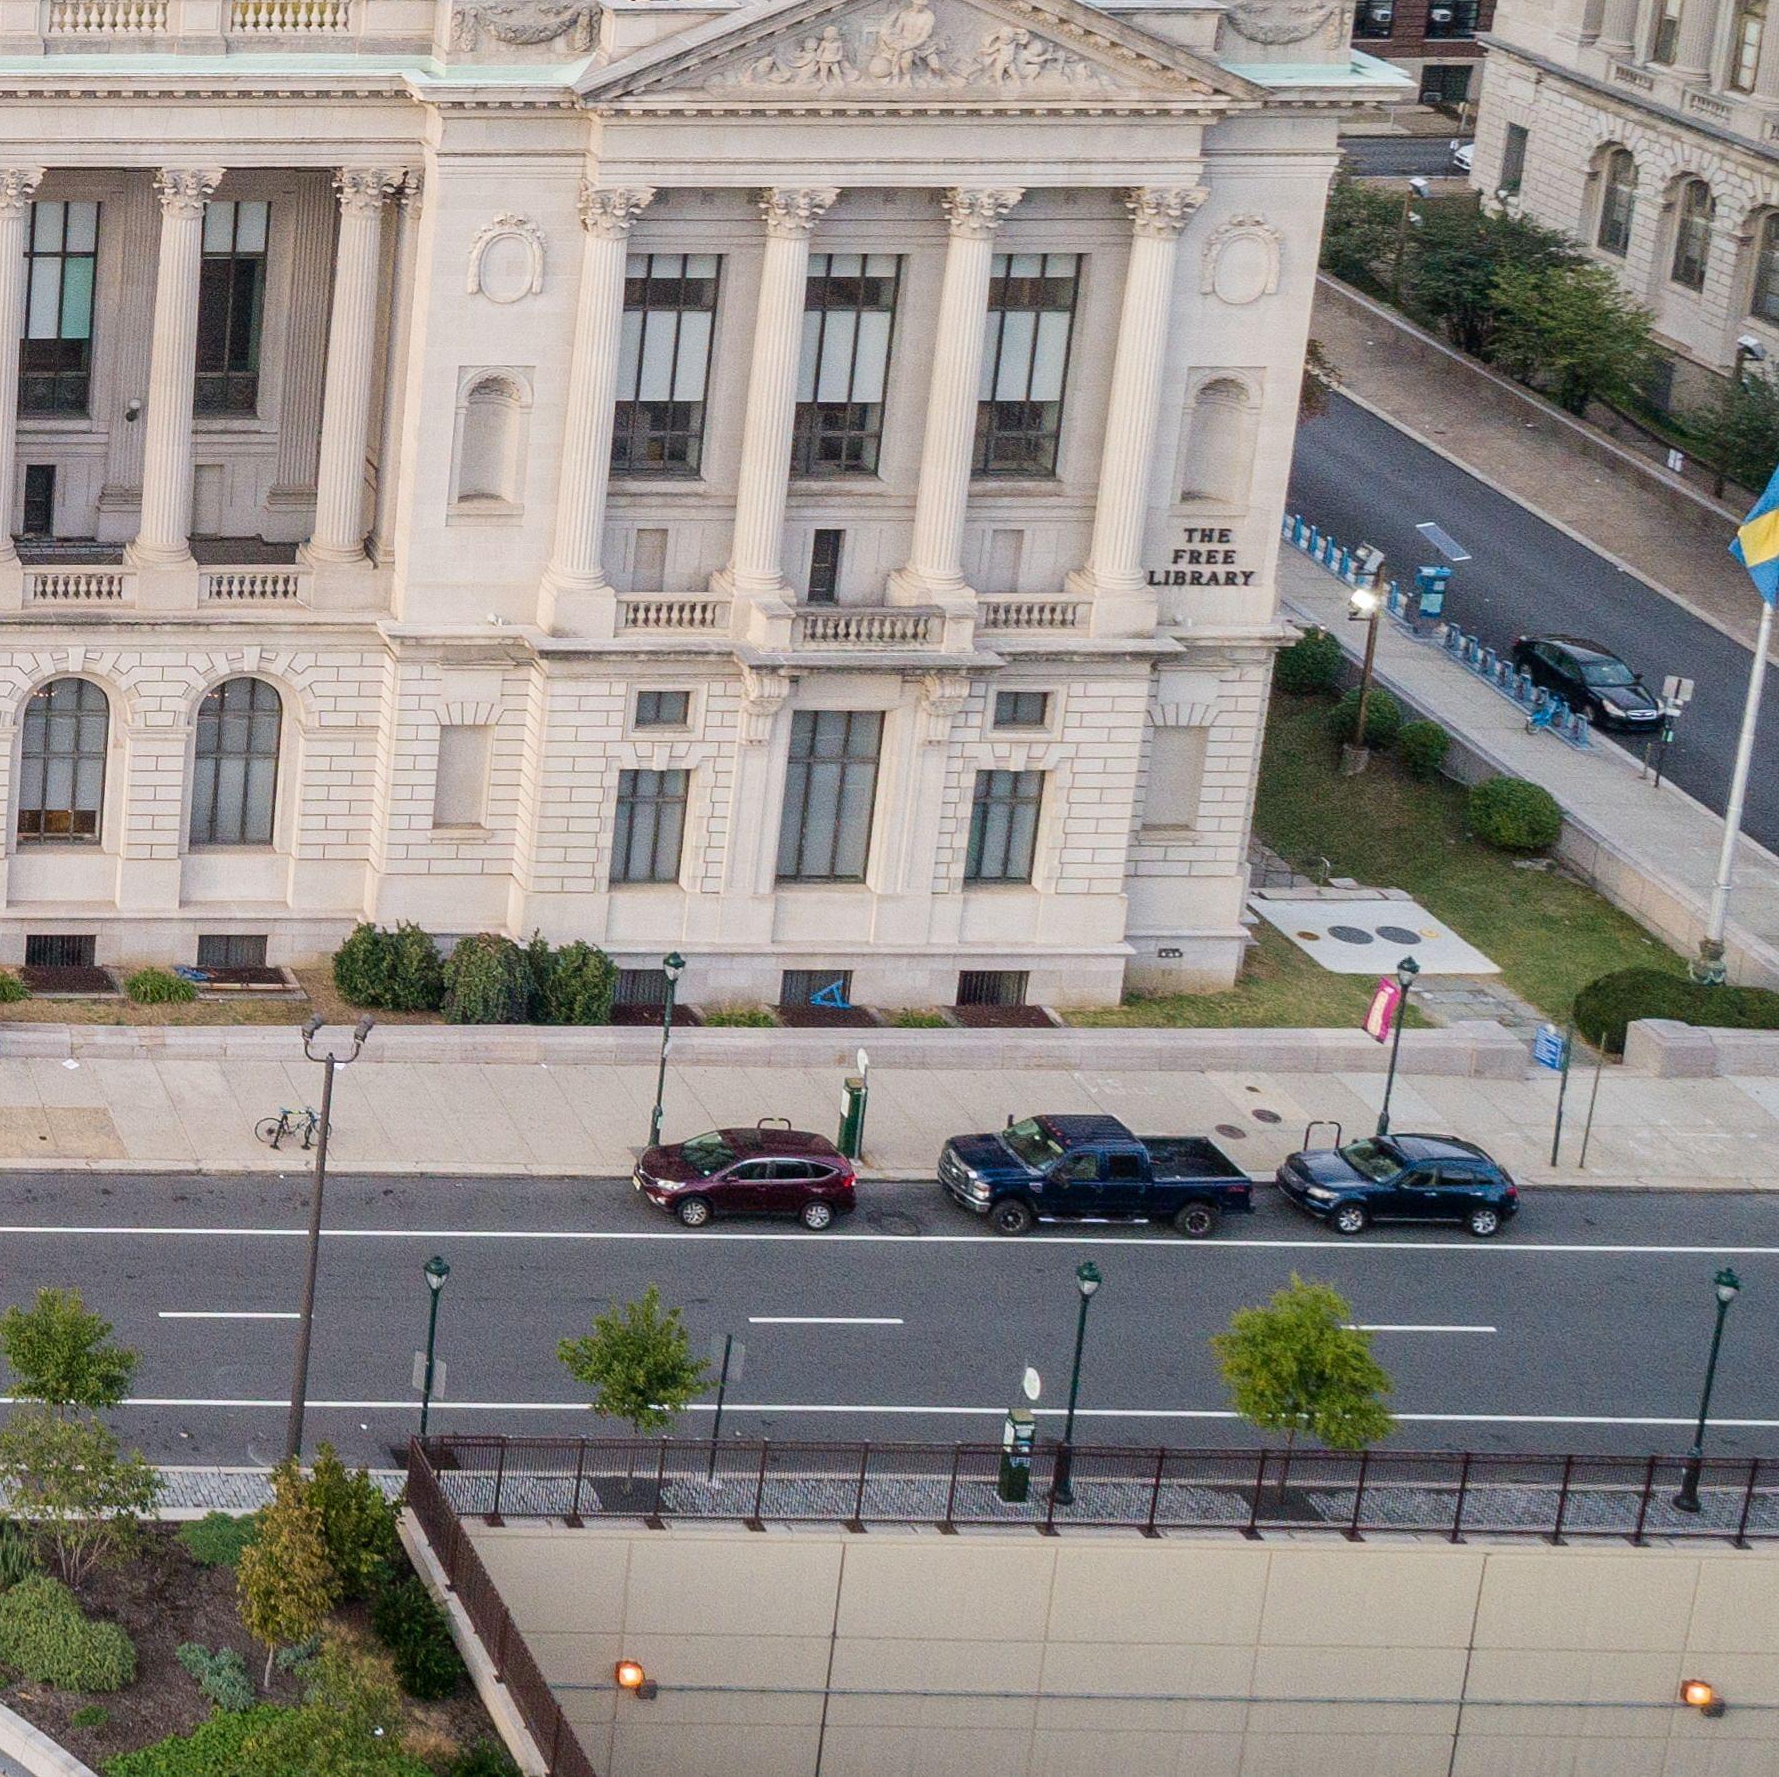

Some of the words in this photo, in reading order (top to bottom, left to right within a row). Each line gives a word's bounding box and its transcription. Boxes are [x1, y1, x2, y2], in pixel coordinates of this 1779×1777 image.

[1183, 527, 1233, 544] THE
[1171, 549, 1237, 565] FREE
[1147, 570, 1255, 587] LIBRARY
